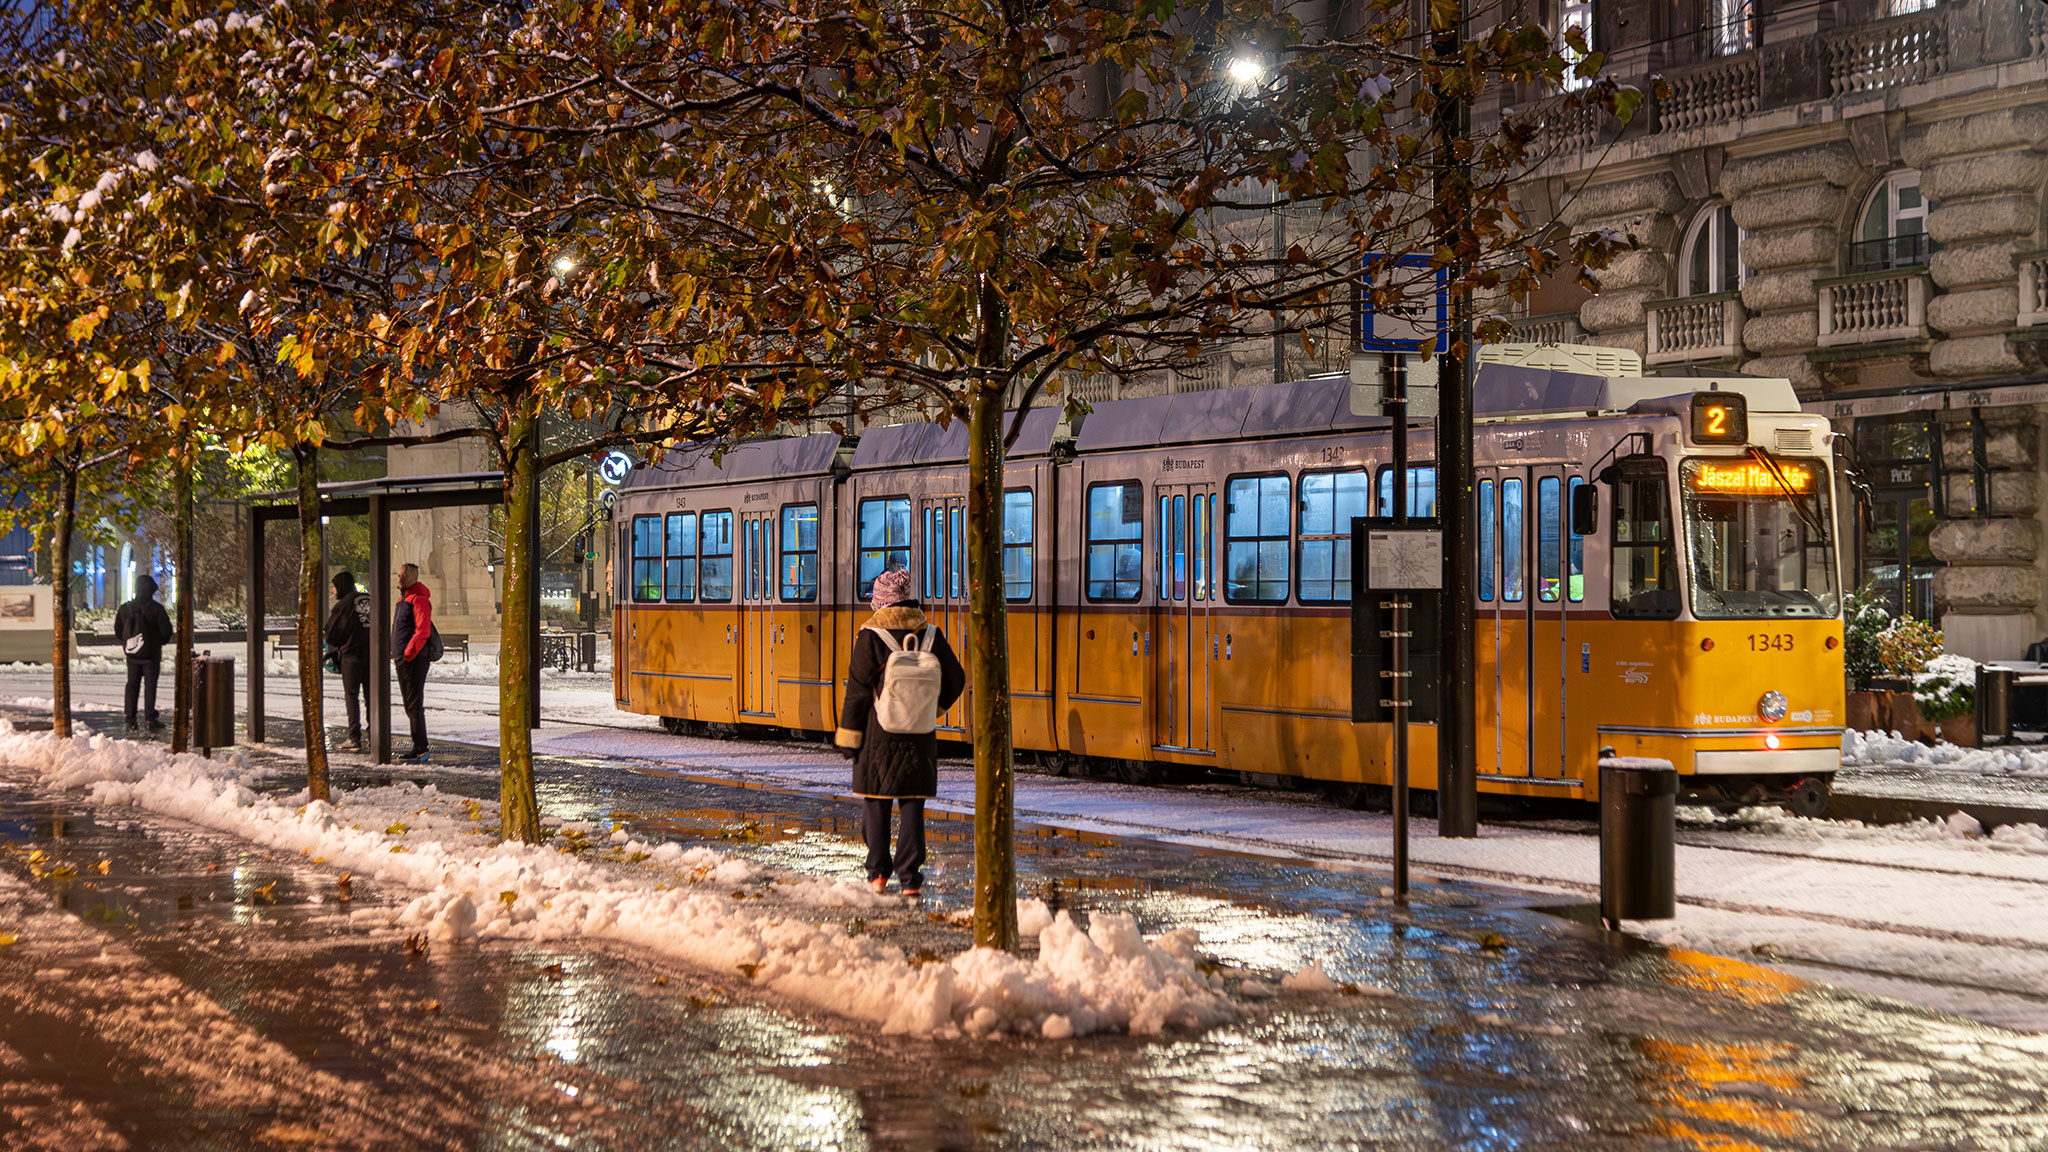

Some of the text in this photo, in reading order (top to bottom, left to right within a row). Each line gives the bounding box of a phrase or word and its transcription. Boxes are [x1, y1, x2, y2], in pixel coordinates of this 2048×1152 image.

[1834, 402, 1854, 417] PICK
[1708, 408, 1725, 433] 2
[1321, 446, 1345, 462] 1343
[1175, 460, 1205, 469] BUDAPEST
[1698, 465, 1745, 486] Jászai
[1891, 468, 1912, 482] PICK
[1747, 634, 1794, 652] 1343
[1713, 715, 1758, 723] BUDAPEST
